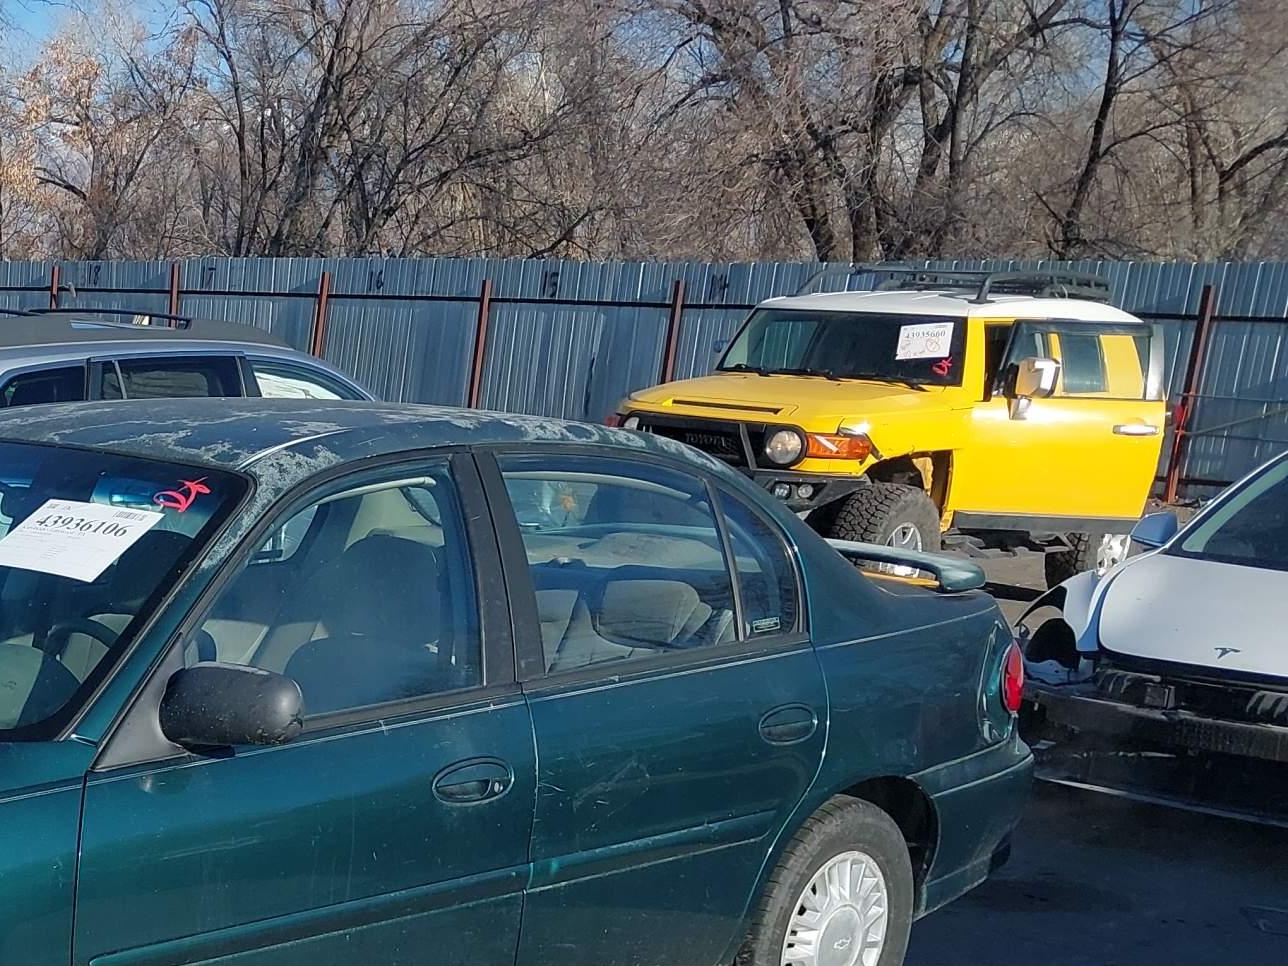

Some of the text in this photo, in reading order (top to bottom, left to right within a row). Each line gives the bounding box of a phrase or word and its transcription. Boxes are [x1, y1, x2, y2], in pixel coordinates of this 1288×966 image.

[88, 263, 101, 286] 18
[369, 270, 383, 291] 16
[542, 271, 559, 297] 15
[36, 514, 130, 537] 43936106
